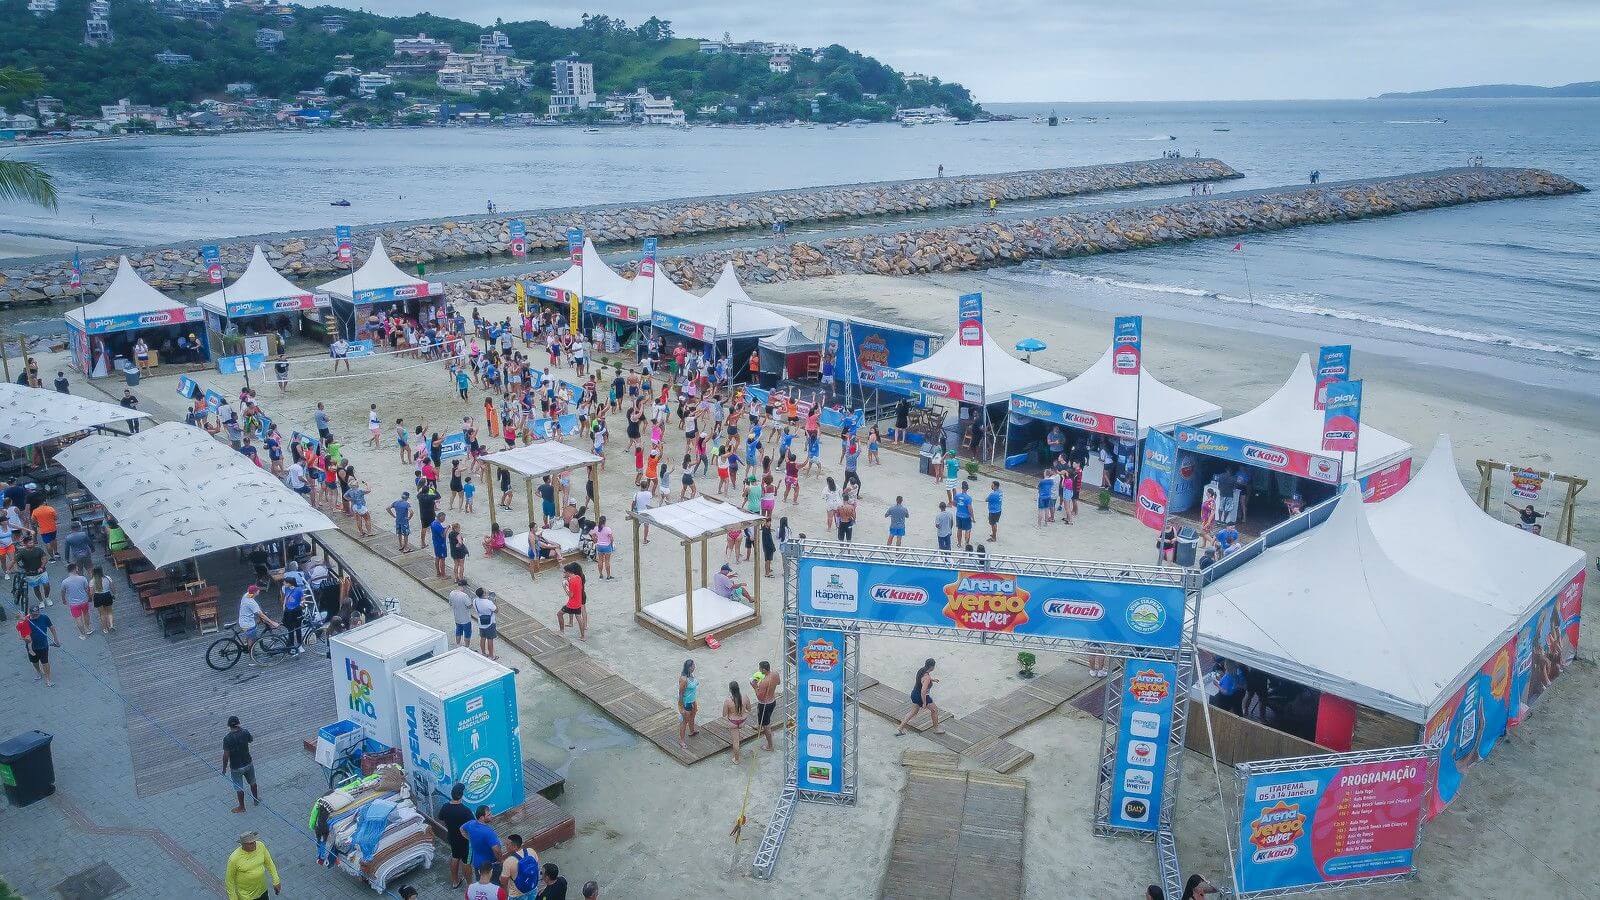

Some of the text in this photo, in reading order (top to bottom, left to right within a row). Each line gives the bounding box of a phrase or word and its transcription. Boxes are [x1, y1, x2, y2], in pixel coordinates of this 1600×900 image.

[882, 370, 898, 379] play
[929, 381, 948, 393] koch
[1019, 399, 1038, 410] play
[1334, 393, 1355, 404] play
[1187, 433, 1212, 445] play
[1258, 450, 1285, 465] koch
[958, 577, 1014, 594] Arena
[815, 589, 855, 601] Itapema
[889, 589, 924, 601] koch
[947, 592, 1025, 613] verão
[1062, 604, 1100, 617] koch
[1340, 765, 1417, 787] PROGRAMAÇÃO
[1269, 783, 1305, 793] ITAPEMA
